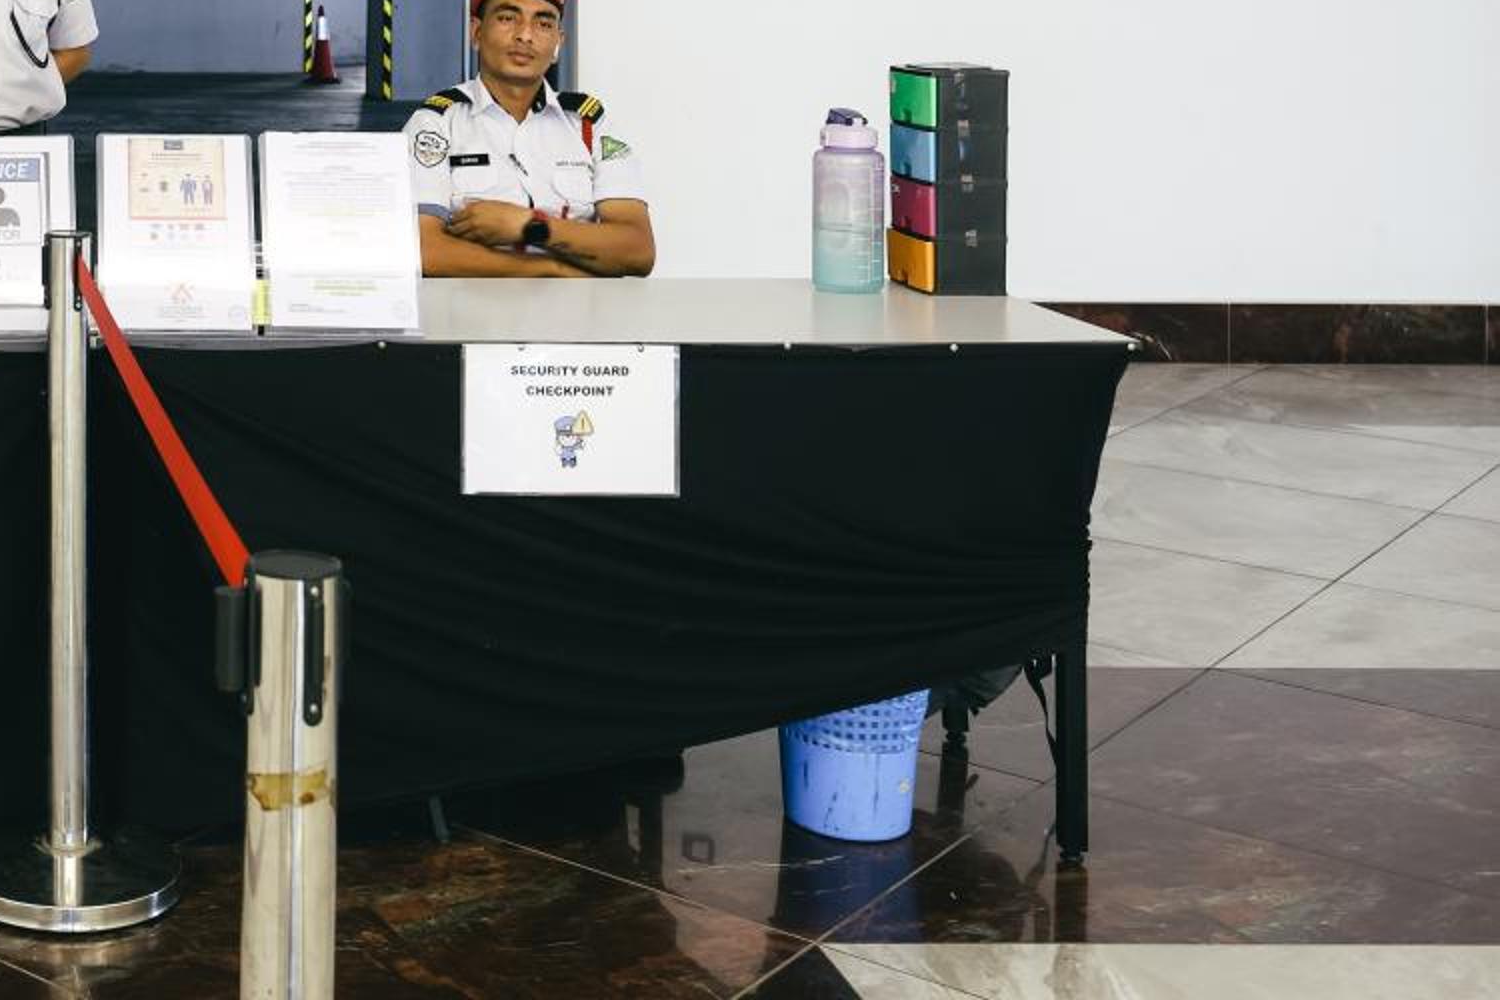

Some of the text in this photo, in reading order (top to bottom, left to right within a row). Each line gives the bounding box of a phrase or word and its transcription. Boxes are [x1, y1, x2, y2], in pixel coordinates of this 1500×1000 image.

[510, 365, 630, 377] SECURITY GUARD
[525, 385, 615, 397] CHECKPOINT
